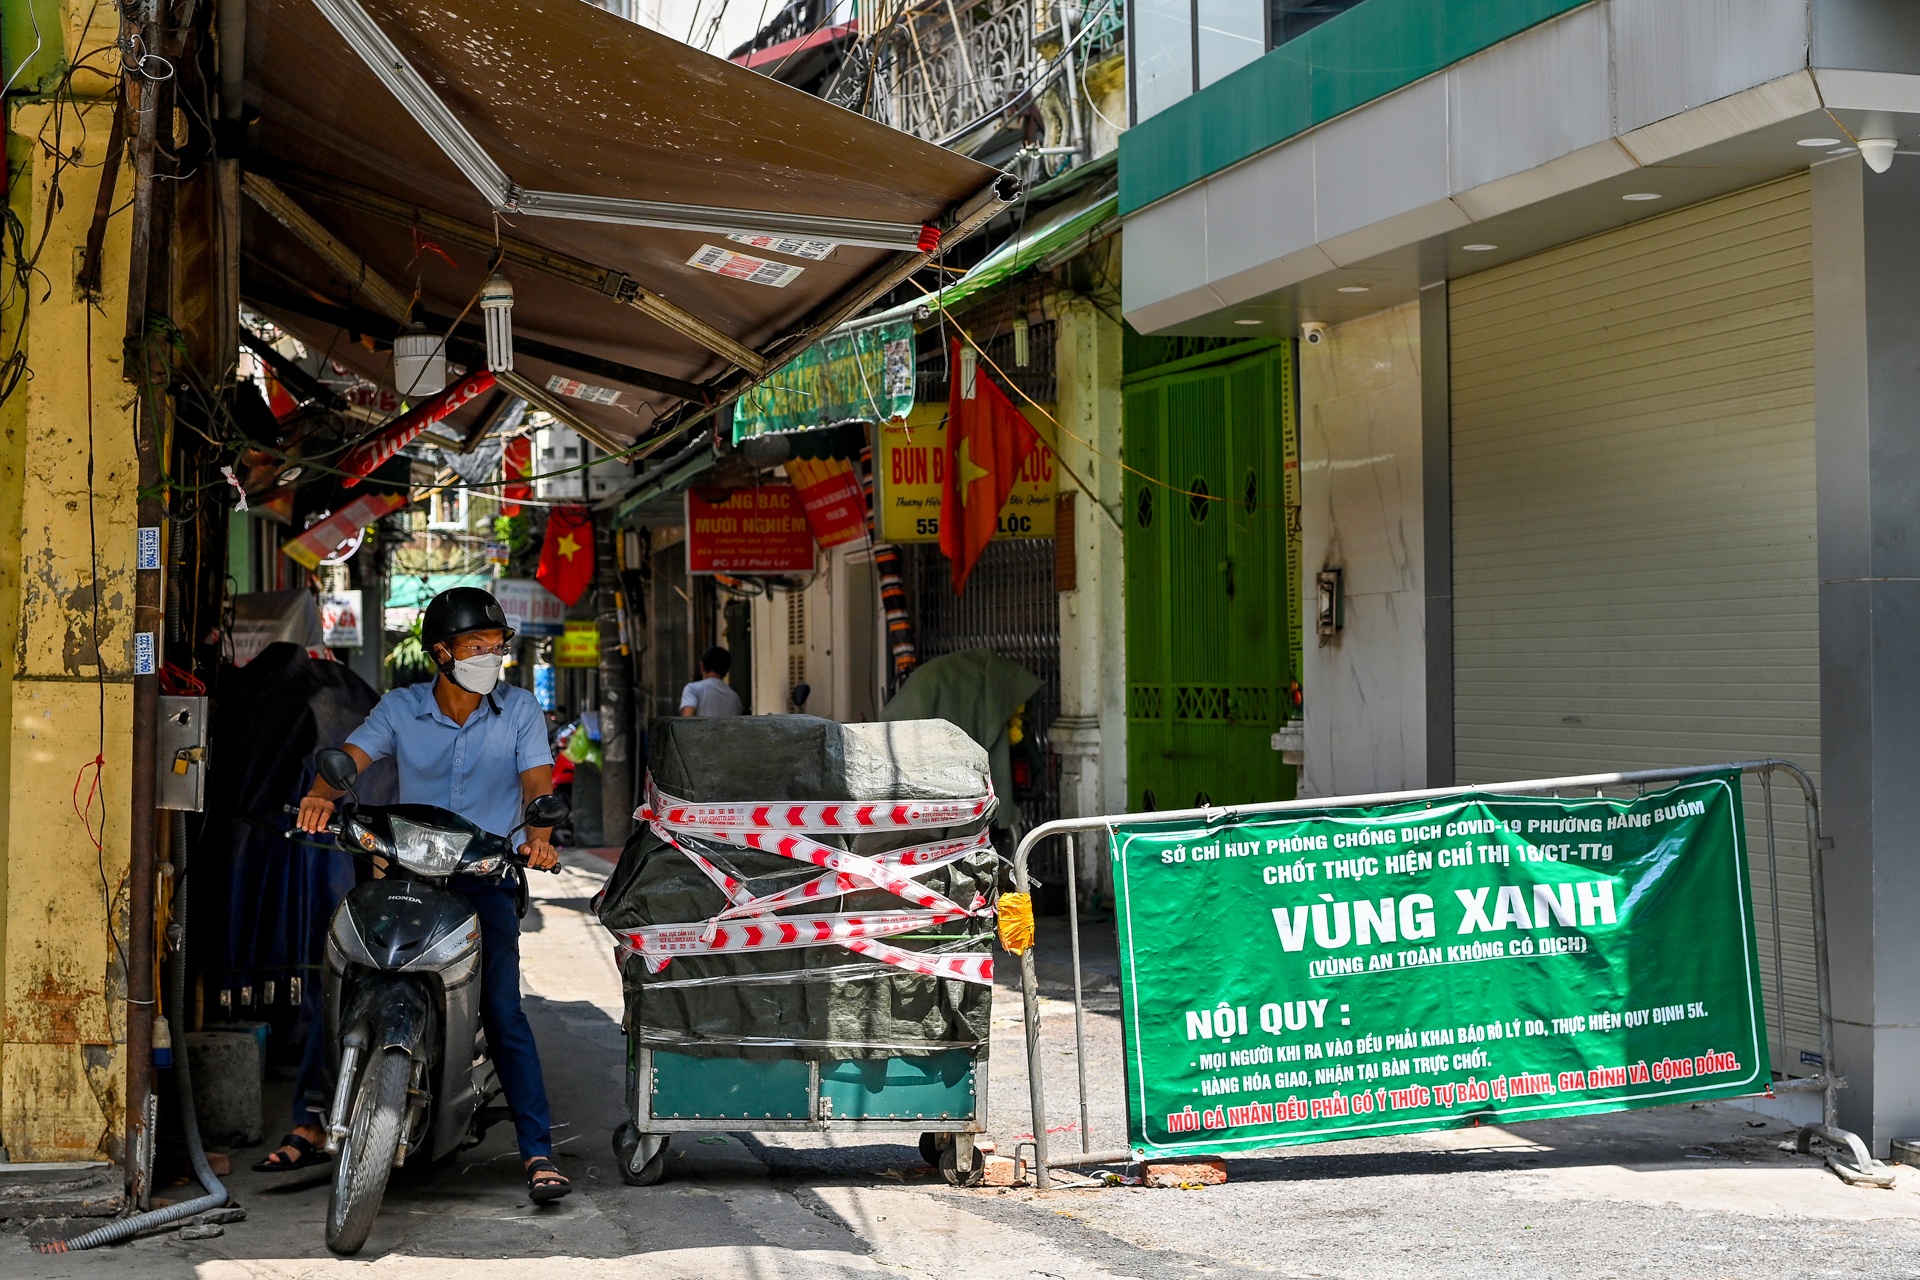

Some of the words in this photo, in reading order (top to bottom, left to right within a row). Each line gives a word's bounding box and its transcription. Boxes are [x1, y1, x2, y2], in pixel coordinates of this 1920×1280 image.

[892, 442, 928, 485] BÚN
[695, 515, 737, 534] MƯỜI
[758, 493, 791, 512] BẠC
[916, 518, 938, 535] 55
[998, 513, 1031, 537] LỘC
[1161, 844, 1186, 864] SỞ
[1192, 839, 1220, 862] CHỈ
[1225, 841, 1260, 858] HUY
[1266, 834, 1328, 855] PHÒNG
[1333, 825, 1396, 849] CHỐNG
[1402, 824, 1442, 845] DỊCH
[1446, 819, 1521, 836] COVID-19
[1528, 815, 1602, 834] PHƯỜNG
[1607, 812, 1651, 831] HÀNG
[1654, 799, 1705, 823] BUỒM
[1263, 857, 1317, 885] CHỐT
[1322, 856, 1379, 881] THỰC
[1385, 850, 1432, 876] HIỆN
[1438, 841, 1473, 868] CHỈ
[1478, 844, 1510, 867] THỊ
[1516, 843, 1613, 863] 16/CT-TTg
[387, 895, 423, 904] HONDA
[1271, 893, 1436, 953] VÙNG
[1453, 880, 1618, 935] XANH
[1308, 955, 1364, 978] (VÙNG
[1368, 952, 1393, 970] AN
[1397, 945, 1442, 967] TOÀN
[1448, 941, 1504, 963] KHÔNG
[1508, 936, 1534, 956] CÓ
[1538, 936, 1587, 955] DỊCH)
[1185, 1001, 1248, 1044] NỘI
[1259, 999, 1329, 1036] QUY
[1200, 1052, 1227, 1073] MỌI
[1230, 1045, 1274, 1068] NGƯỜI
[1276, 1045, 1301, 1063] KHI
[1305, 1042, 1323, 1060] RA
[1325, 1037, 1353, 1058] VÀO
[1356, 1032, 1383, 1055] ĐỀU
[1385, 1027, 1418, 1051] PHẢI
[1421, 1028, 1454, 1047] KHAI
[1457, 1023, 1485, 1044] BÁO
[1486, 1021, 1502, 1041] RÕ
[1505, 1018, 1522, 1038] LÝ
[1525, 1019, 1548, 1038] DO,
[1551, 1014, 1586, 1037] THỰC
[1588, 1010, 1622, 1033] HIỆN
[1624, 1008, 1650, 1029] QUY
[1652, 1005, 1685, 1026] ĐỊNH
[1687, 1001, 1709, 1018] 5K.
[1168, 1104, 1200, 1134] MỖI
[1203, 1104, 1225, 1130] CÁ
[1228, 1099, 1273, 1128] NHÂN
[1276, 1095, 1308, 1122] ĐỀU
[1312, 1090, 1350, 1119] PHẢI
[1352, 1091, 1374, 1115] CÓ
[1375, 1087, 1387, 1112] Ý
[1389, 1083, 1430, 1110] THỨC
[1434, 1082, 1456, 1109] TỰ
[1456, 1077, 1489, 1102] BẢO
[1490, 1076, 1507, 1103] VỆ
[1510, 1072, 1556, 1096] MÌNH,
[1558, 1070, 1586, 1092] GIA
[1588, 1063, 1626, 1089] ĐÌNH
[1629, 1060, 1650, 1084] VÀ
[1652, 1057, 1692, 1084] CỘNG
[1695, 1049, 1740, 1077] ĐỒNG.
[1201, 1072, 1239, 1097] HÀNG
[1242, 1070, 1271, 1092] HÓA
[1275, 1071, 1312, 1089] GIAO,
[1315, 1063, 1354, 1086] NHẬN
[1357, 1063, 1379, 1084] TẠI
[1382, 1056, 1410, 1078] BÀN
[1413, 1053, 1449, 1075] TRỰC
[1452, 1047, 1492, 1071] CHỐT.
